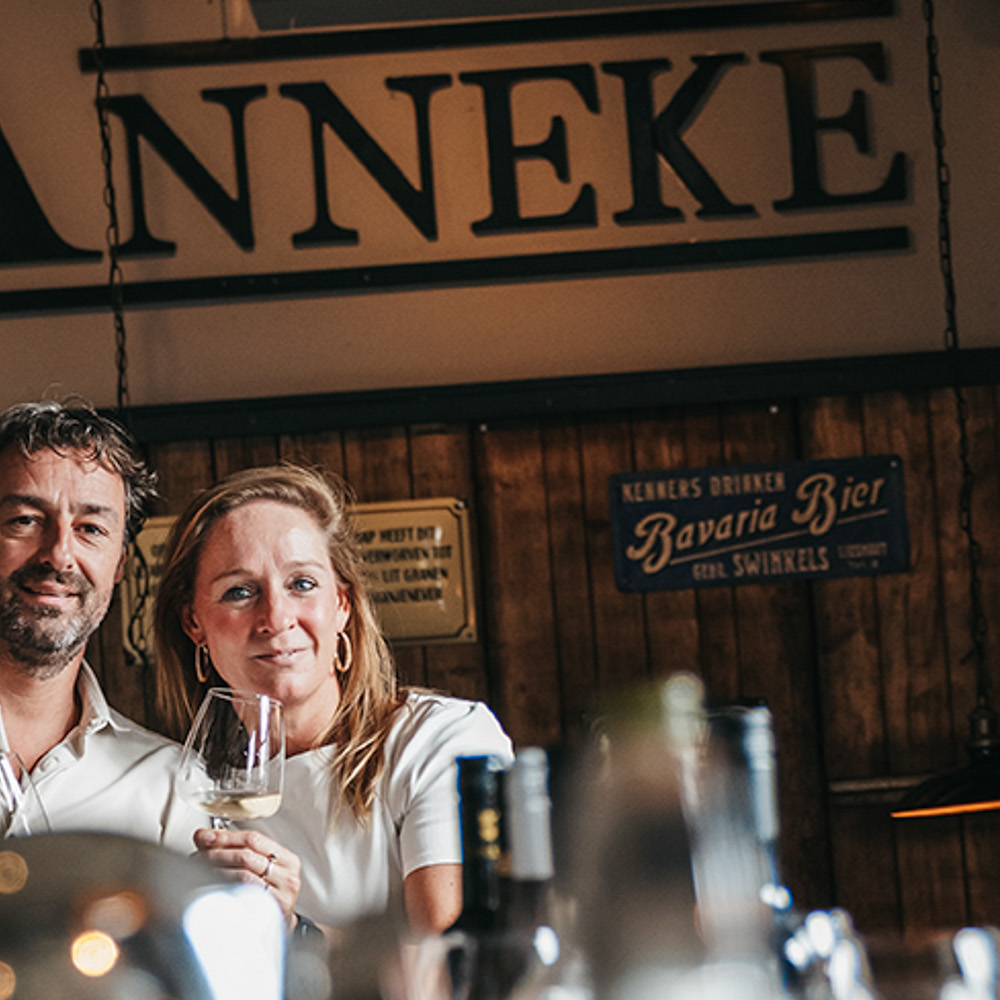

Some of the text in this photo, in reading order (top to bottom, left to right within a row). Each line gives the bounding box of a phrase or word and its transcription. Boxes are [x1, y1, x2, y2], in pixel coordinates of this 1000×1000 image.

[621, 471, 786, 503] KENNERS DRINKEN
[626, 472, 885, 574] Bavaria Bier
[732, 546, 831, 578] SWINKELS
